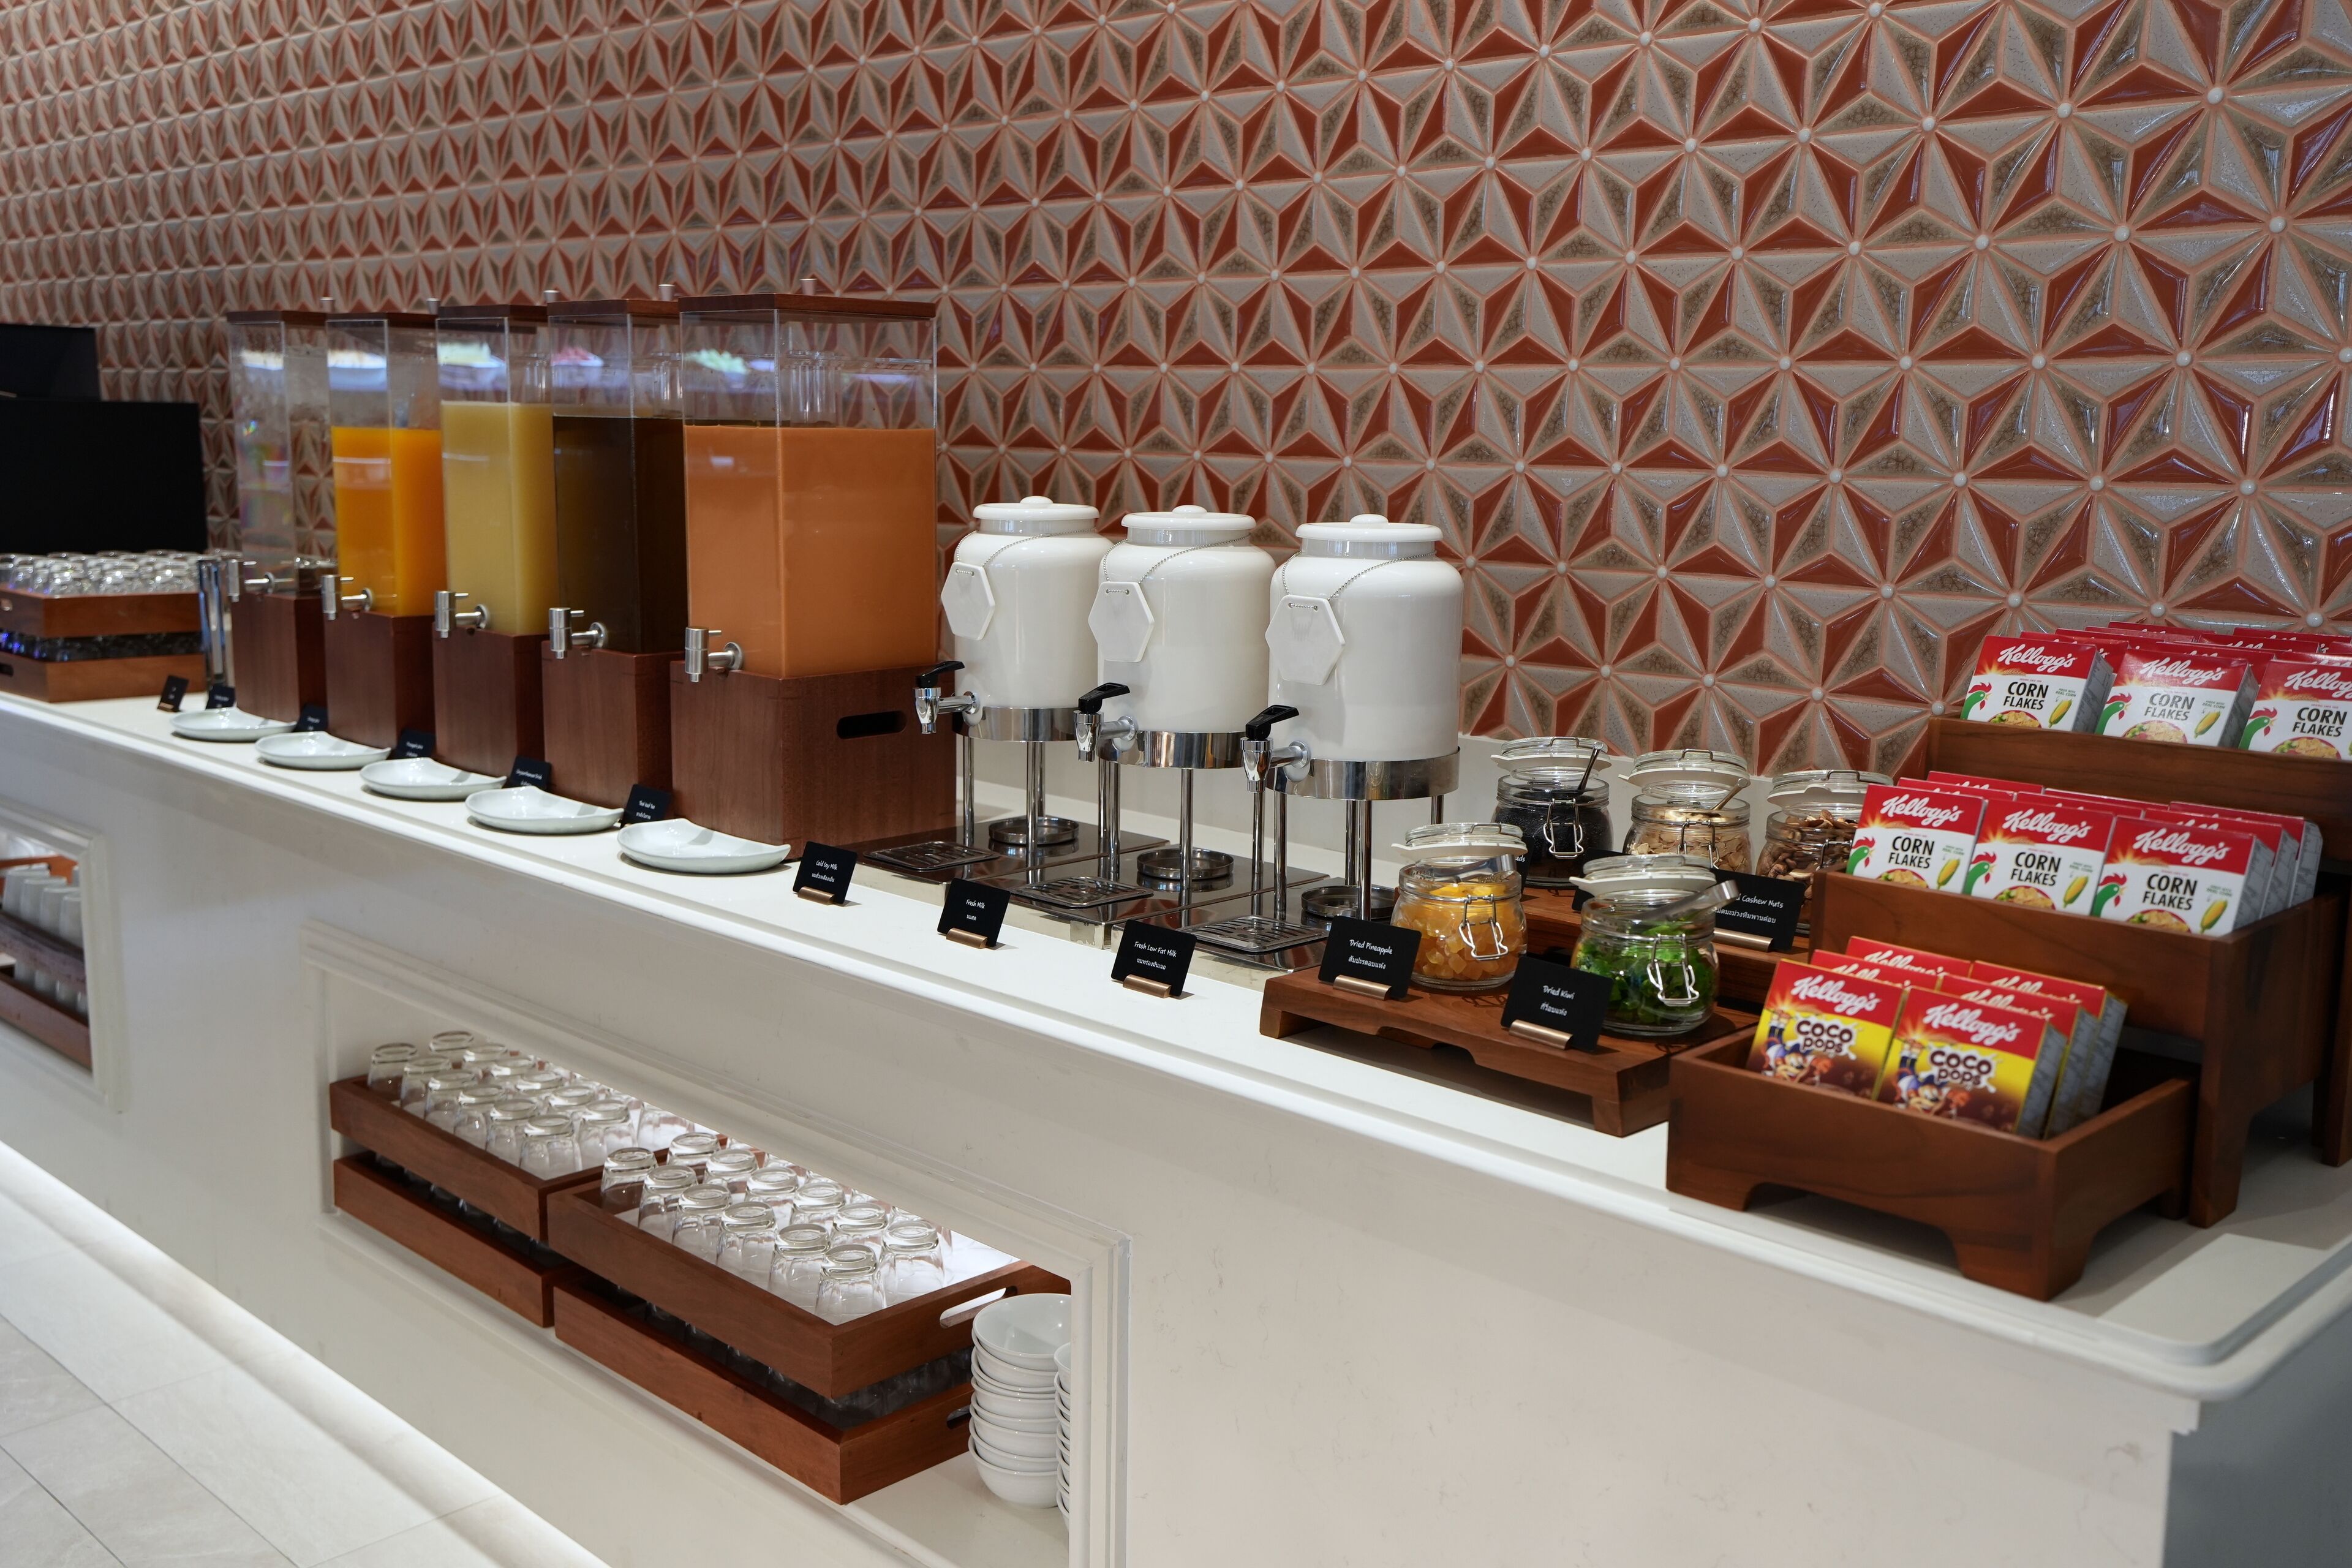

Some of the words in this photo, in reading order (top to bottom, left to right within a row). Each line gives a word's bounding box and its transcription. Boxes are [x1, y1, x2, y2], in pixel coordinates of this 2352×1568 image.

[1997, 644, 2077, 673] Kellogg's
[2139, 657, 2227, 685] Kellogg's
[2008, 682, 2049, 698] CORN
[2003, 696, 2045, 710] FLAKES
[2149, 693, 2195, 710] CORN
[2144, 707, 2190, 721] FLAKES
[2297, 707, 2347, 725] CORN
[2292, 722, 2343, 737] FLAKES
[1880, 794, 1964, 827] Kellogg's
[2002, 809, 2092, 843] Kellogg's
[1892, 836, 1935, 856] CORN
[2133, 828, 2231, 865] Kellogg's
[1888, 852, 1932, 869] FLAKES
[2015, 852, 2061, 873] CORN
[2010, 869, 2057, 886] FLAKES
[2147, 874, 2198, 897] CORN
[1742, 895, 1767, 904] Cashew
[1768, 900, 1784, 908] Nuts
[2142, 891, 2193, 910] FLAKES
[1349, 939, 1365, 949] Dried
[1365, 942, 1393, 955] Pineapple
[1543, 985, 1561, 996] Dried
[1560, 990, 1575, 1000] Kiwi
[1790, 974, 1881, 1016] Kellogg's
[1923, 1003, 2022, 1046] Kellogg's
